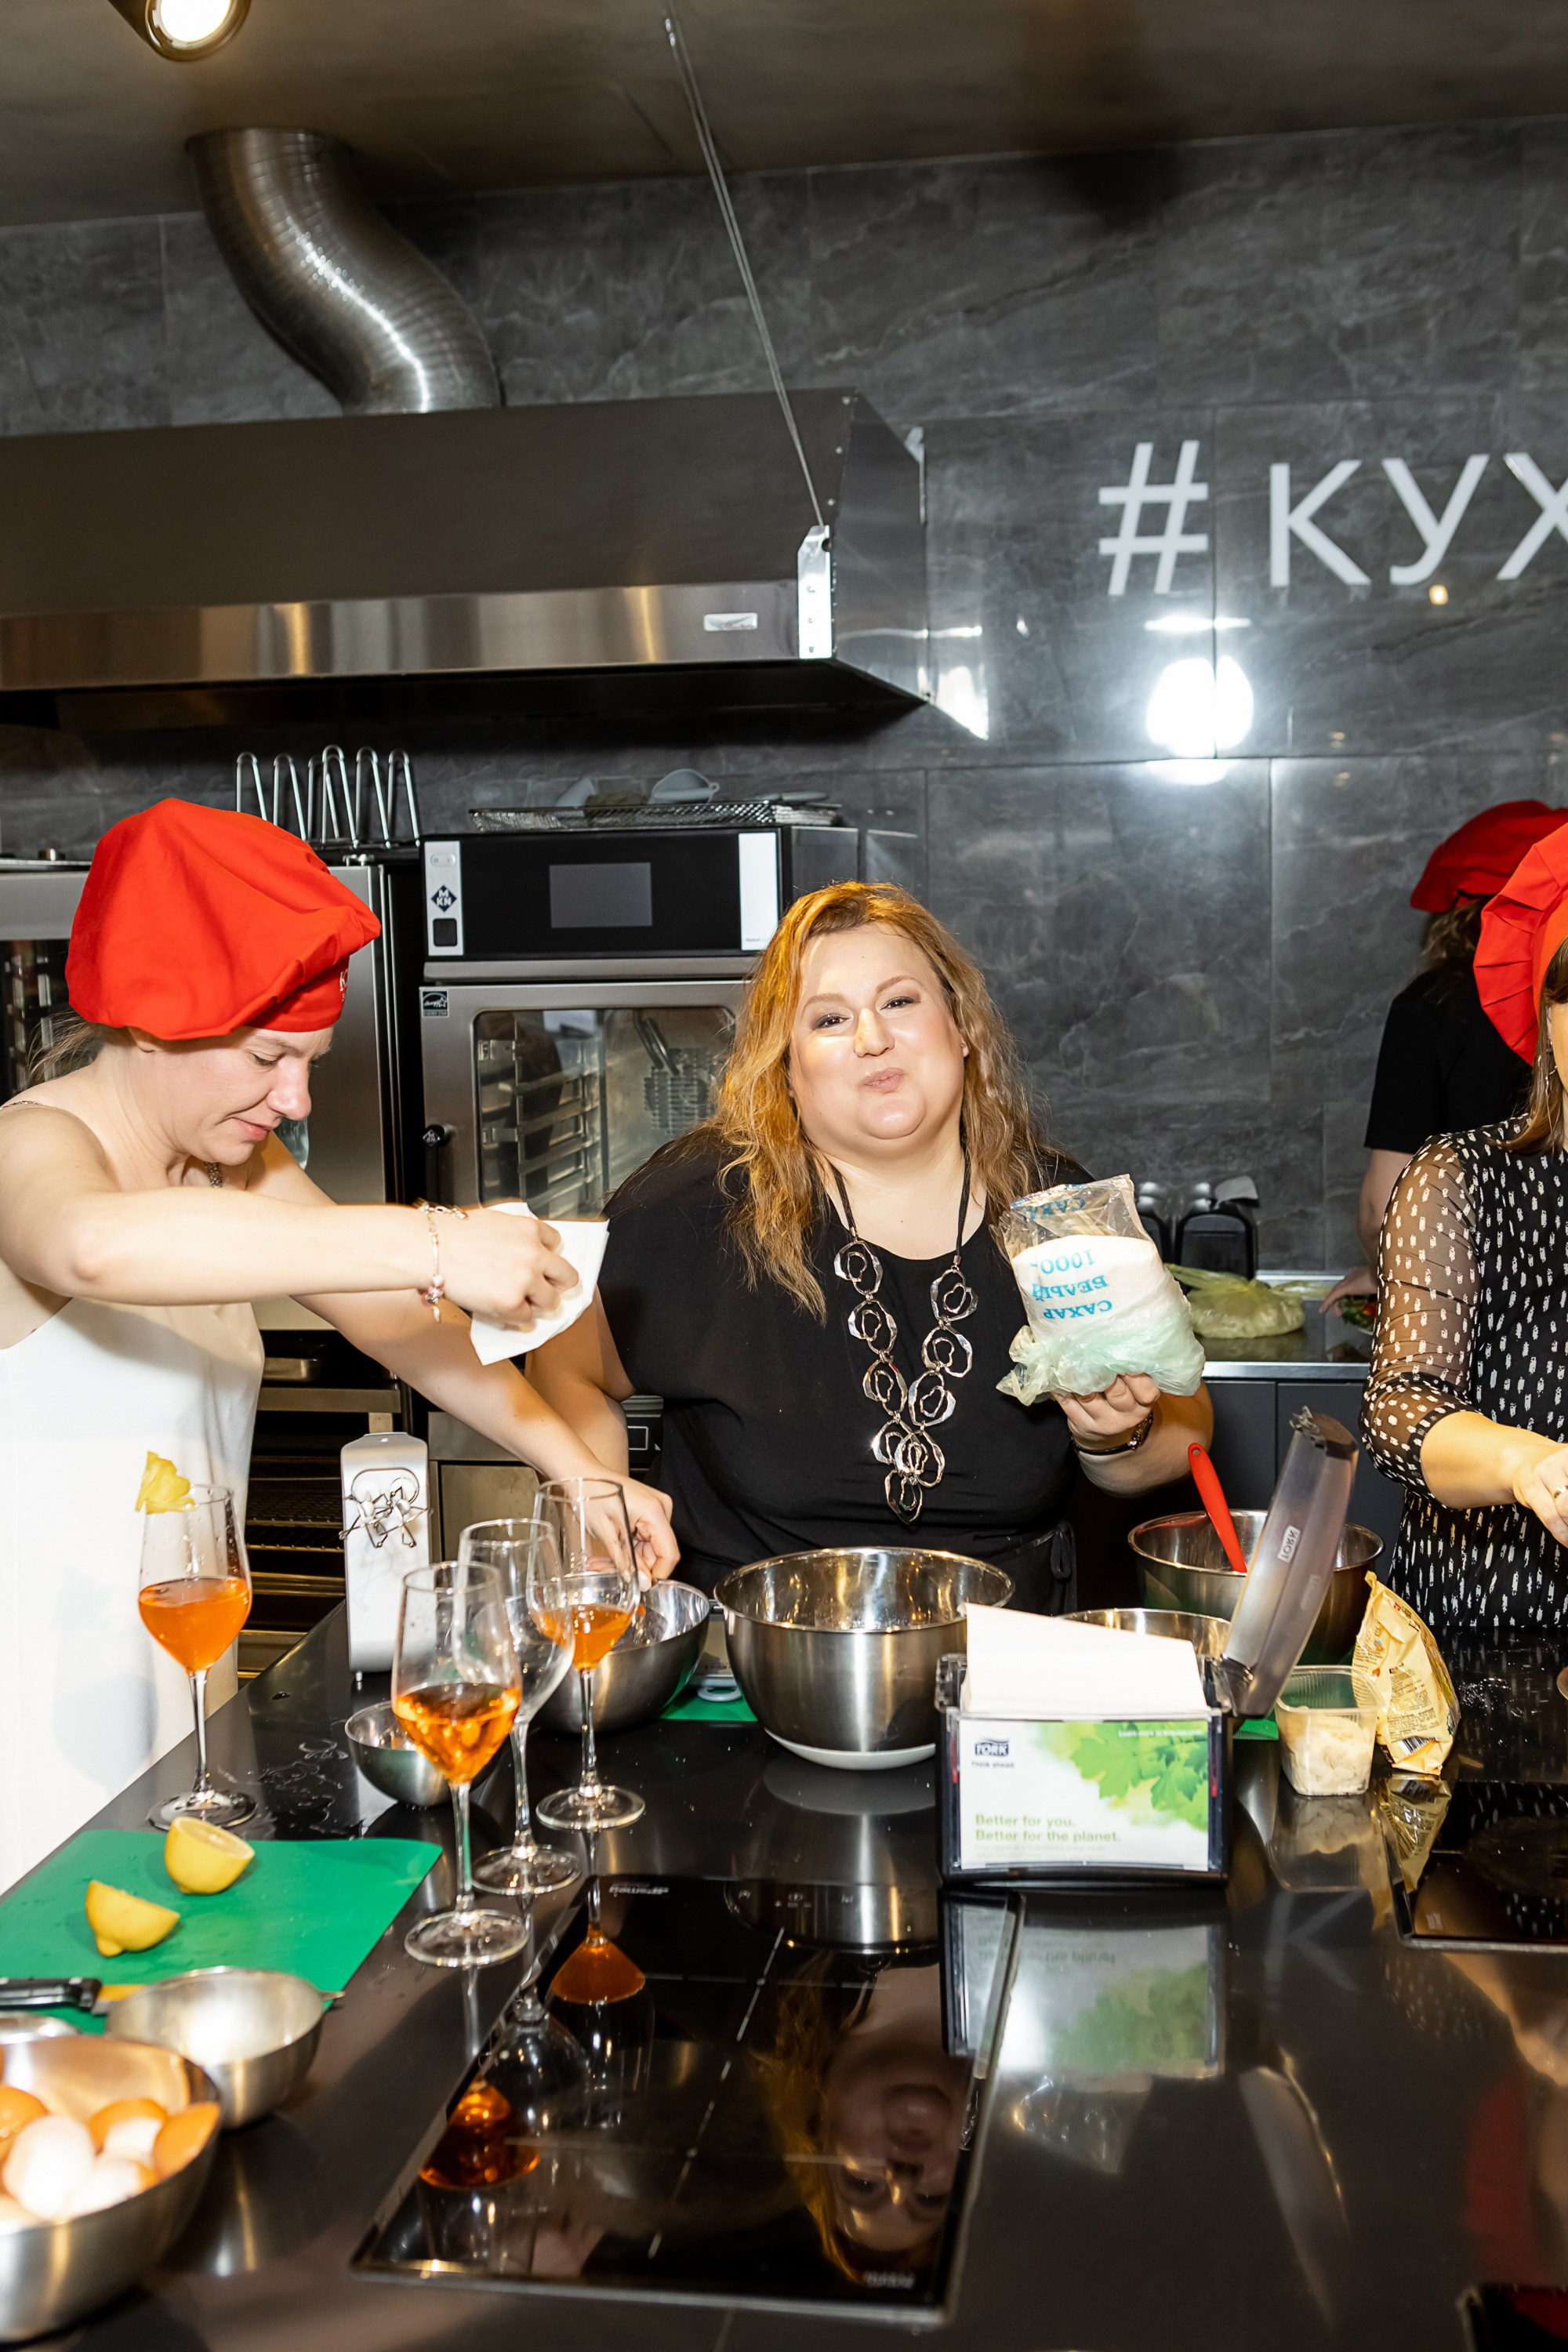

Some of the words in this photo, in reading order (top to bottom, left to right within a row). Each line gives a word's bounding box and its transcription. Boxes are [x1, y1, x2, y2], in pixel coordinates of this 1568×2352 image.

[1031, 1275, 1109, 1301] БЕЛЫЙ
[1043, 1299, 1113, 1320] САХАР
[975, 1742, 1008, 1756] TORK
[975, 1814, 1018, 1827] Better
[1022, 1815, 1041, 1827] for
[1047, 1817, 1076, 1829] you.
[975, 1829, 1018, 1842] Better
[1022, 1830, 1041, 1842] for
[1047, 1831, 1069, 1842] the
[1073, 1831, 1121, 1844] planet.
